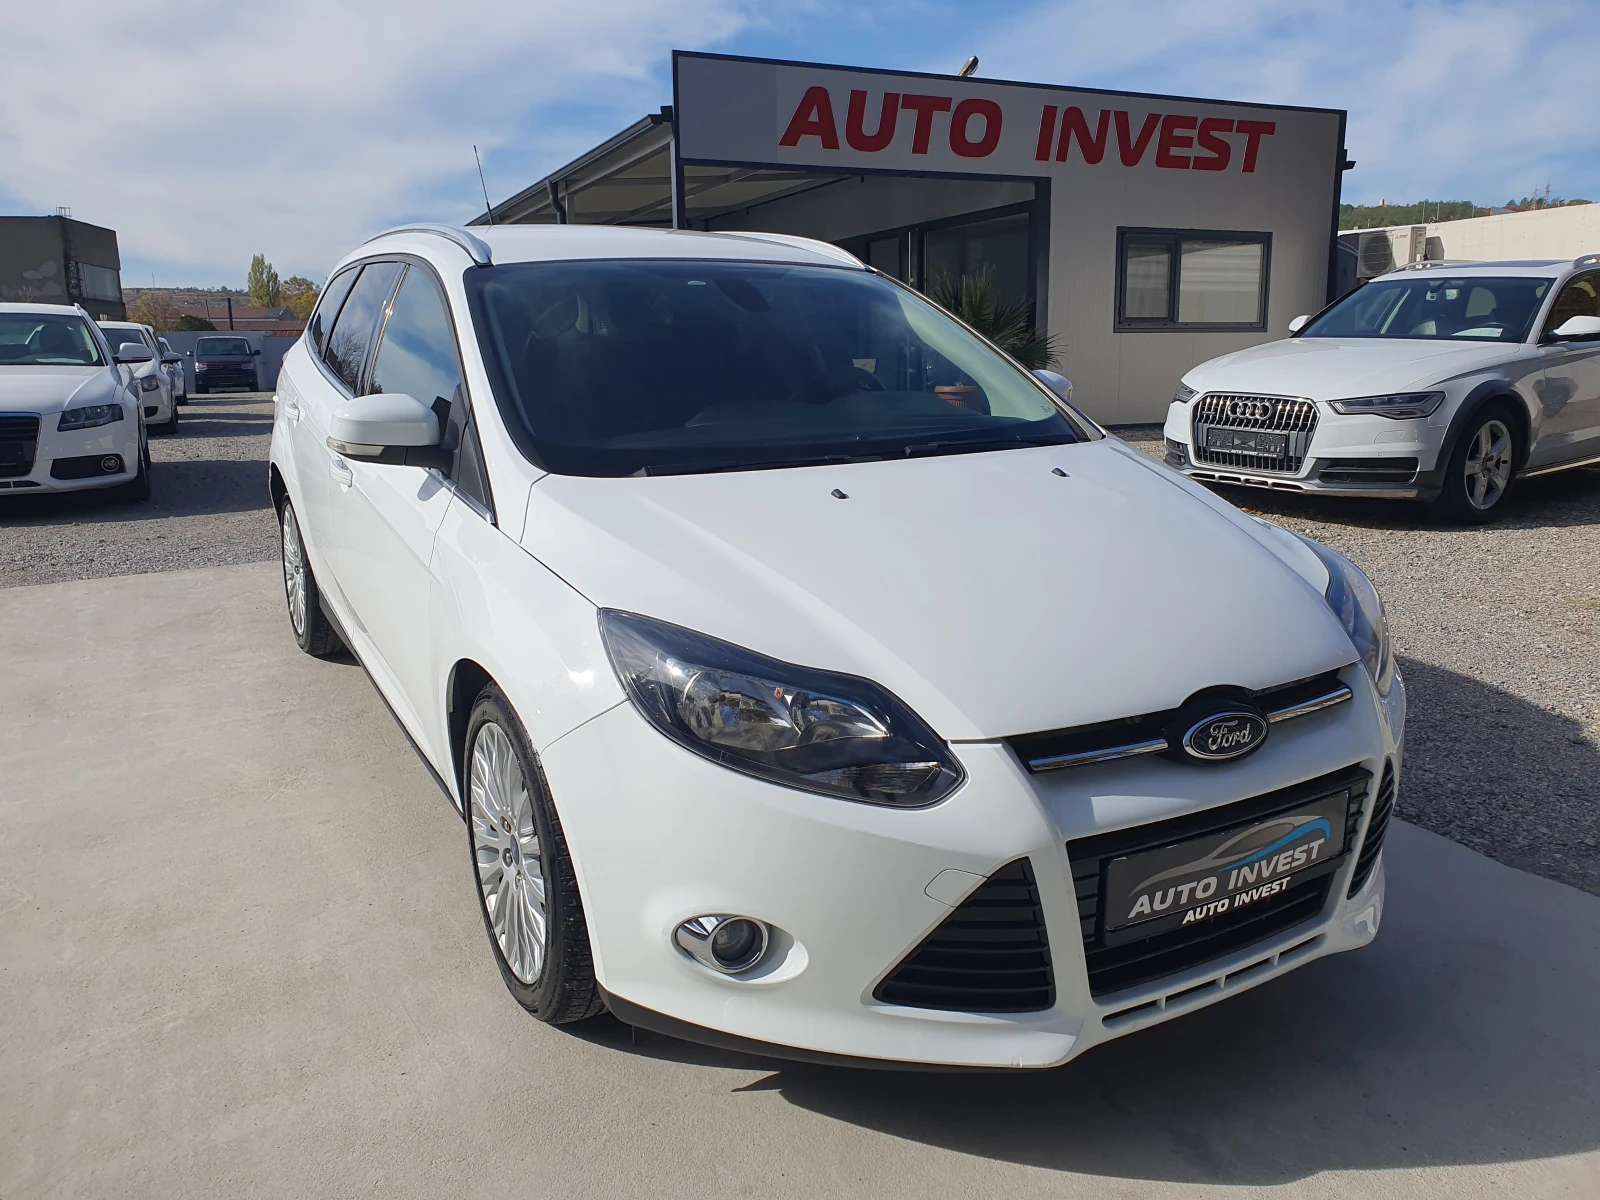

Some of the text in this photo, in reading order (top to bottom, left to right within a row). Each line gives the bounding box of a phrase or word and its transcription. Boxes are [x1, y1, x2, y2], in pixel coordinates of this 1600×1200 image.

[778, 86, 1277, 173] AUTO INVEST
[1208, 720, 1252, 751] Ford
[1127, 838, 1325, 919] AUTO INVEST
[1182, 877, 1291, 925] AUTO INVEST
